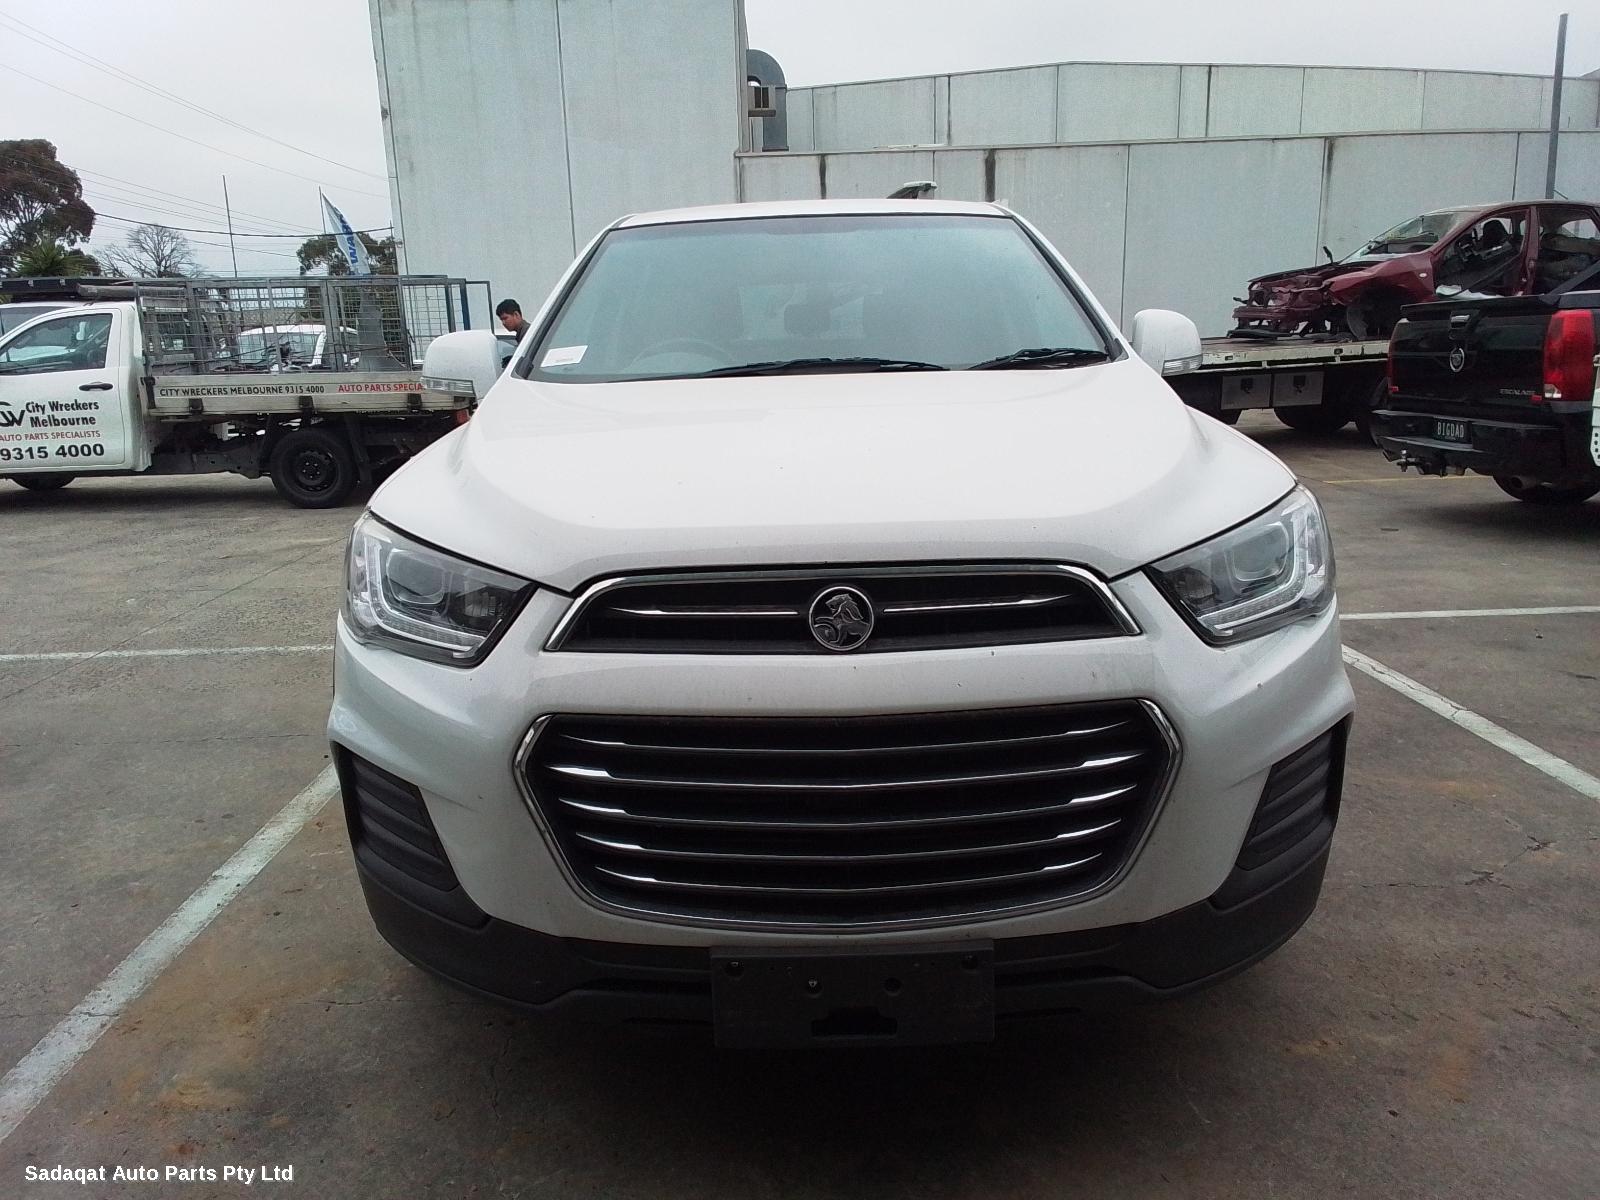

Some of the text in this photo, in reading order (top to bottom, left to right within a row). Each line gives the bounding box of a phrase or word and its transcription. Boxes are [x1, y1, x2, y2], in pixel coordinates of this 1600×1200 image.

[160, 385, 325, 396] CITY WRECKERS MELBOURNE 9315 4000
[338, 382, 423, 392] AUTO PARTS SPECIA
[26, 399, 99, 415] City Wreckers
[30, 415, 96, 428] Melbourne
[0, 430, 101, 441] AUTO PARTS SPECIALISTS
[1437, 421, 1465, 437] BIGDAD
[0, 443, 105, 460] 9315 4000
